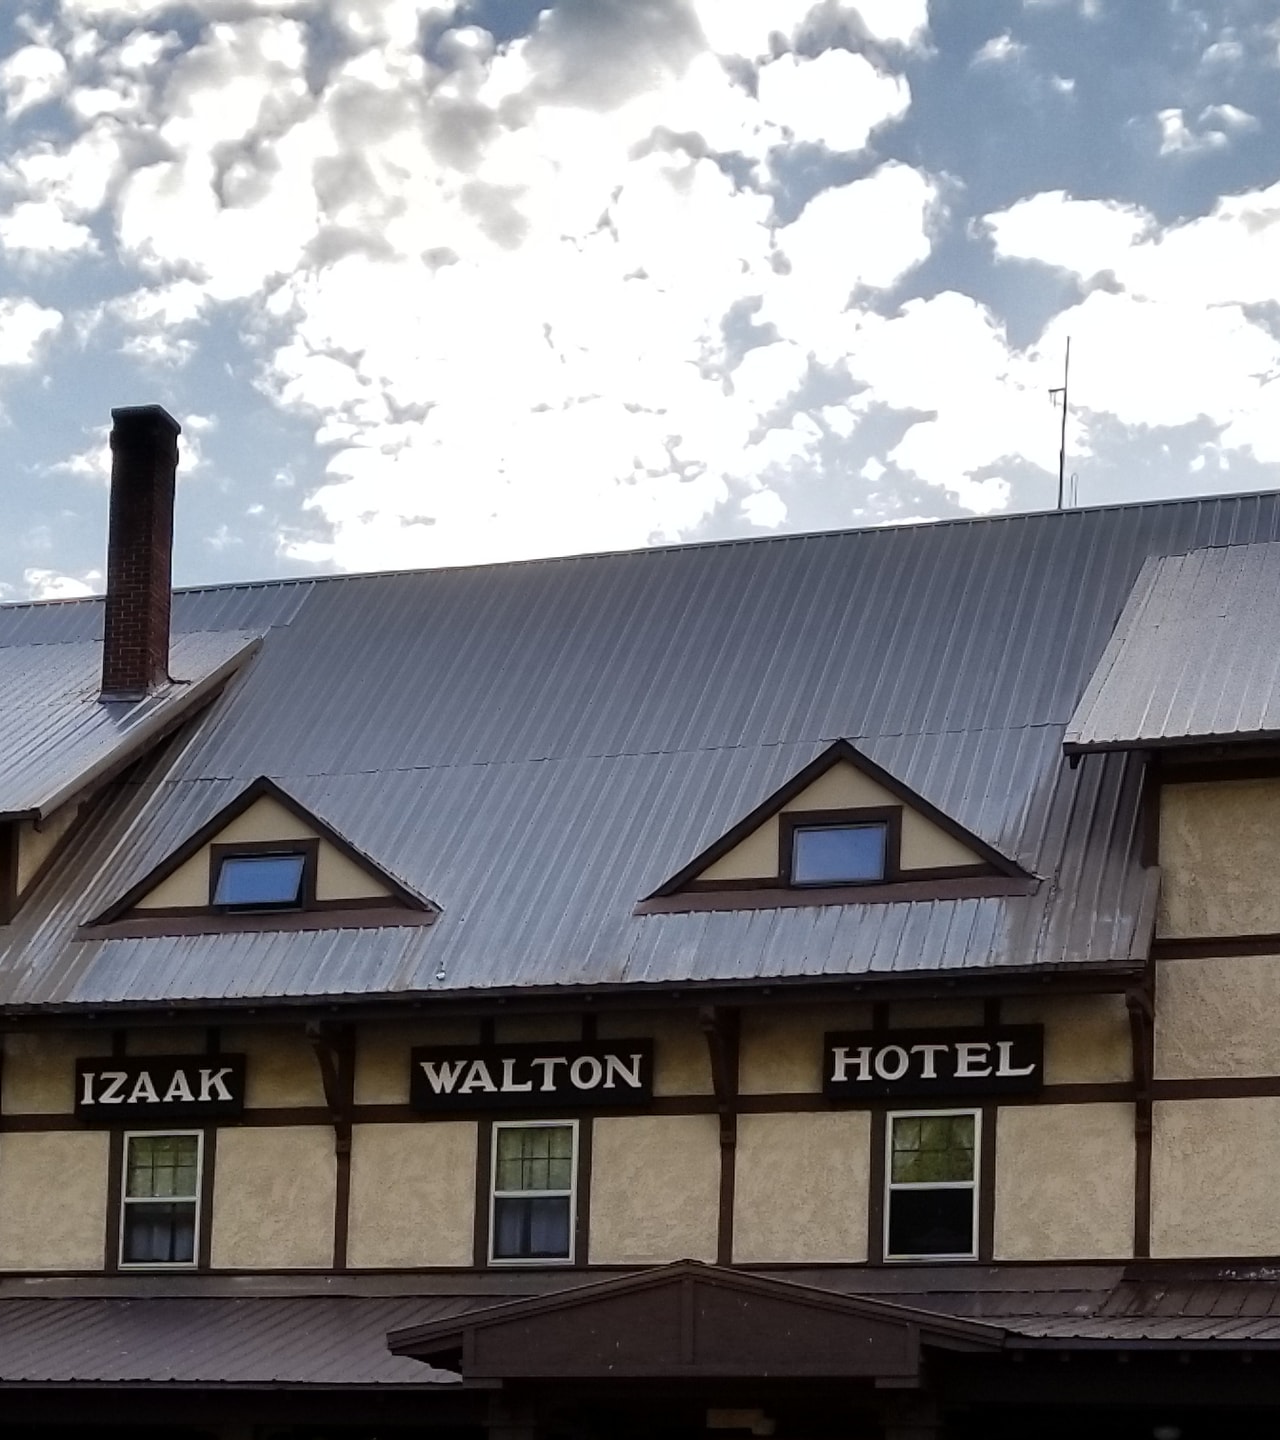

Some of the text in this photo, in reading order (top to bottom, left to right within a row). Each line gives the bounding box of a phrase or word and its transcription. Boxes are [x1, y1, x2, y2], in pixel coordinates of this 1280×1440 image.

[80, 1041, 1036, 1105] IZAAK WALTON HOTEL
